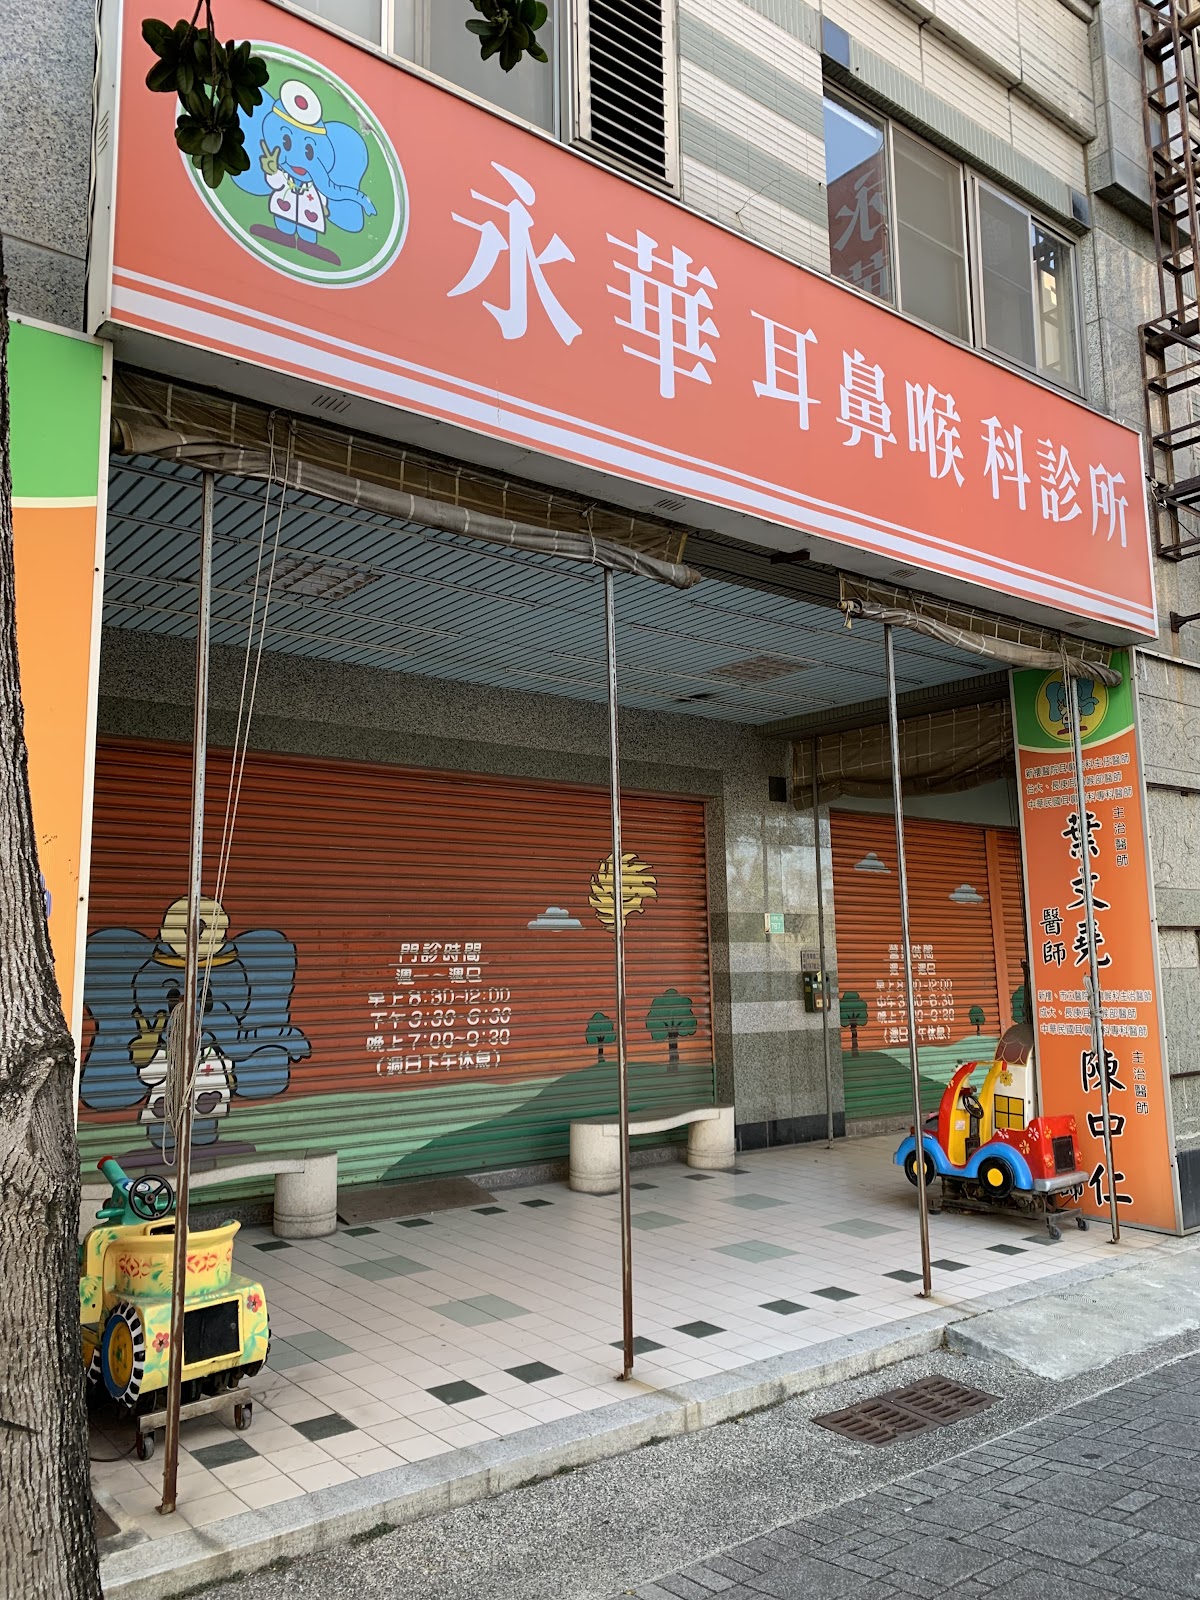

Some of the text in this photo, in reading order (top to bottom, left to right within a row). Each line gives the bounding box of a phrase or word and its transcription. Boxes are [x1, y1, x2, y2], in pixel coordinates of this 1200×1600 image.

[447, 160, 1129, 549] 永華耳鼻喉科診所
[1025, 752, 1130, 779] 新樓醫院耳鼻科主任醫師
[1026, 771, 1122, 795] 台大、長庚耳喉部醫師
[1027, 786, 1133, 810] 中華民國耳鼻科專科醫師
[1112, 806, 1129, 867] 主治醫師
[1040, 907, 1067, 968] 醫師
[399, 942, 482, 963] 門診時間
[888, 944, 934, 960] 營時間
[1039, 1005, 1137, 1020] 成大、長庚耳喉部醫師
[883, 1024, 951, 1044] (週日午休息)
[1040, 1023, 1148, 1038] 中華民國耳鼻科專科醫師
[1132, 1050, 1149, 1115] 主治醫師
[1081, 1049, 1133, 1206] 陳中仁
